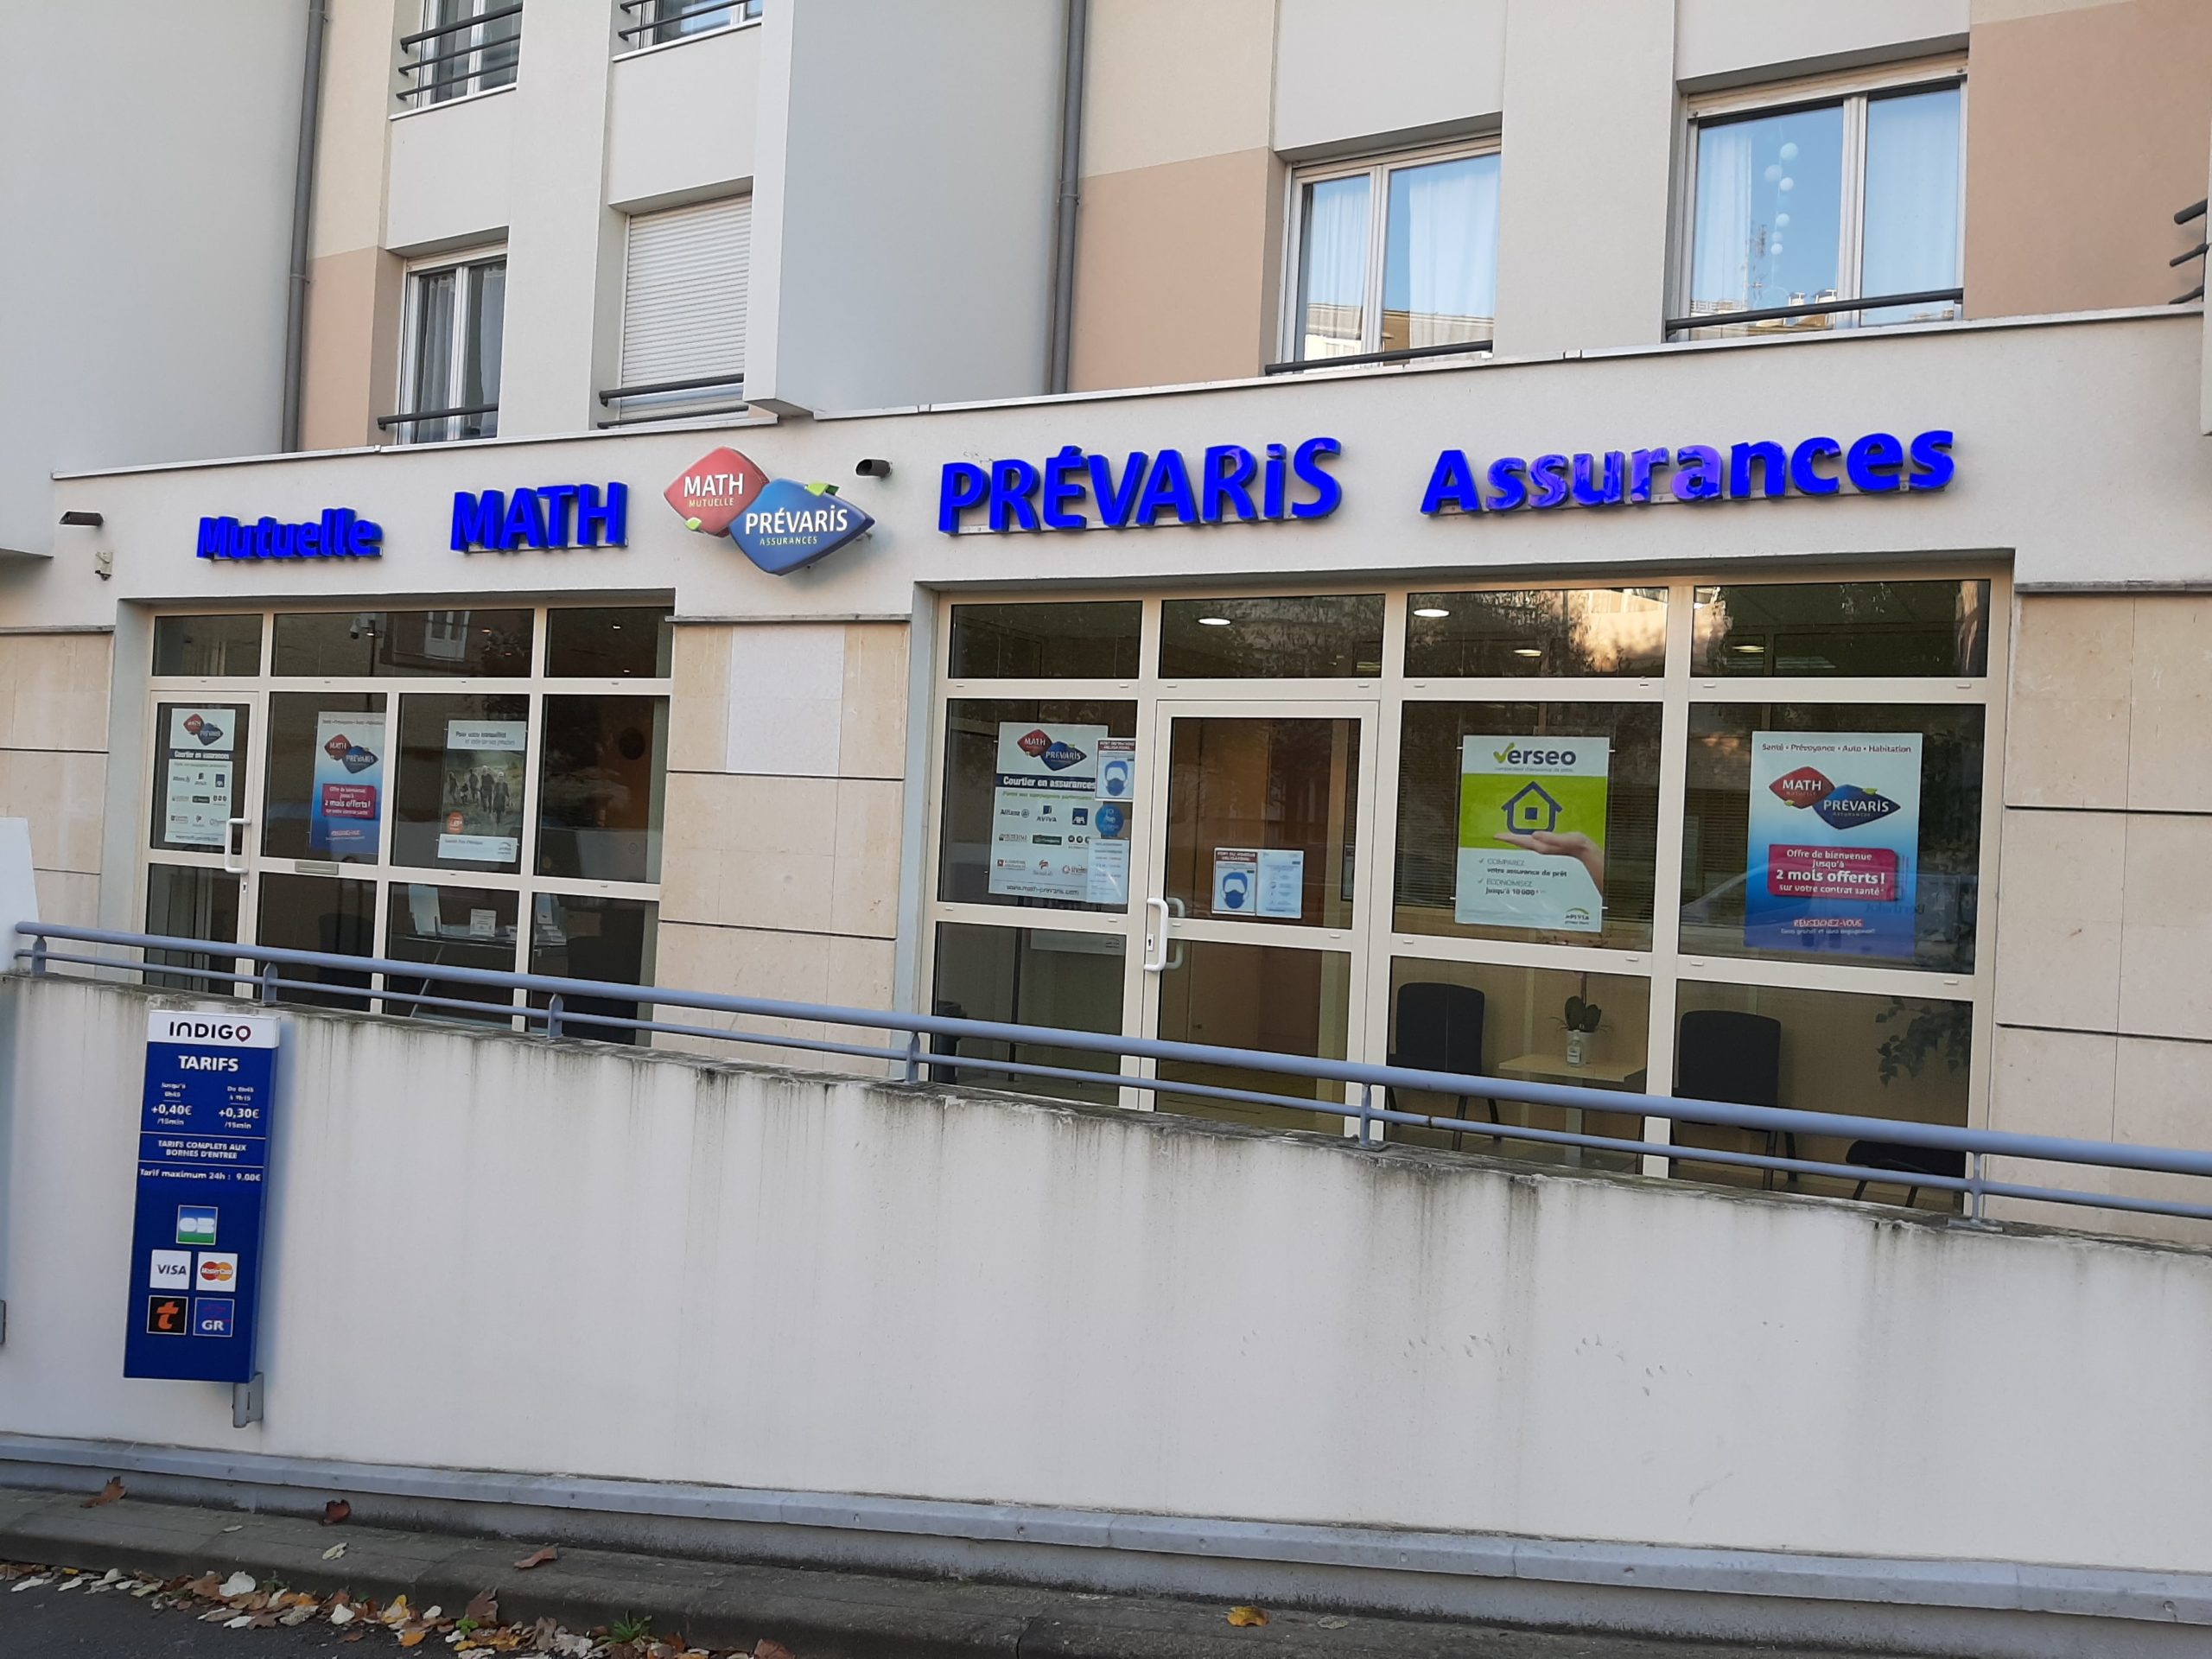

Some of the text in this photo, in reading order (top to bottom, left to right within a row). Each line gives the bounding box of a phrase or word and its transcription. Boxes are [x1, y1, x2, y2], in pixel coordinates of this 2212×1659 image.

[1421, 429, 1956, 517] Assurances
[683, 473, 744, 499] MATH
[689, 497, 734, 508] MUTUELLE
[196, 481, 629, 563] Mutuelle MATH
[759, 536, 818, 547] ASSURANCES
[1790, 743, 1835, 753] Prévoyance
[1868, 745, 1911, 753] Habitation
[1003, 776, 1036, 786] Courtier
[1783, 779, 1822, 791] MATH
[1786, 849, 1809, 858] Offre
[1824, 850, 1872, 861] bienvenue
[1812, 860, 1845, 869] jusqu'à
[1776, 869, 1783, 880] 2
[1788, 870, 1823, 881] mois
[1795, 884, 1819, 893] votre
[1820, 885, 1853, 894] contrat
[169, 1021, 251, 1042] INDIGO
[178, 1055, 238, 1072] TARIFS
[151, 1103, 193, 1116] +0,40€
[219, 1108, 260, 1119] +0,30€
[158, 1140, 184, 1148] TARIFS
[186, 1141, 228, 1151] COMPLETS
[166, 1149, 199, 1158] BORNES
[140, 1168, 159, 1177] Tarif
[209, 1172, 226, 1180] 24h
[157, 1264, 187, 1275] VISA
[201, 1319, 225, 1332] GR
